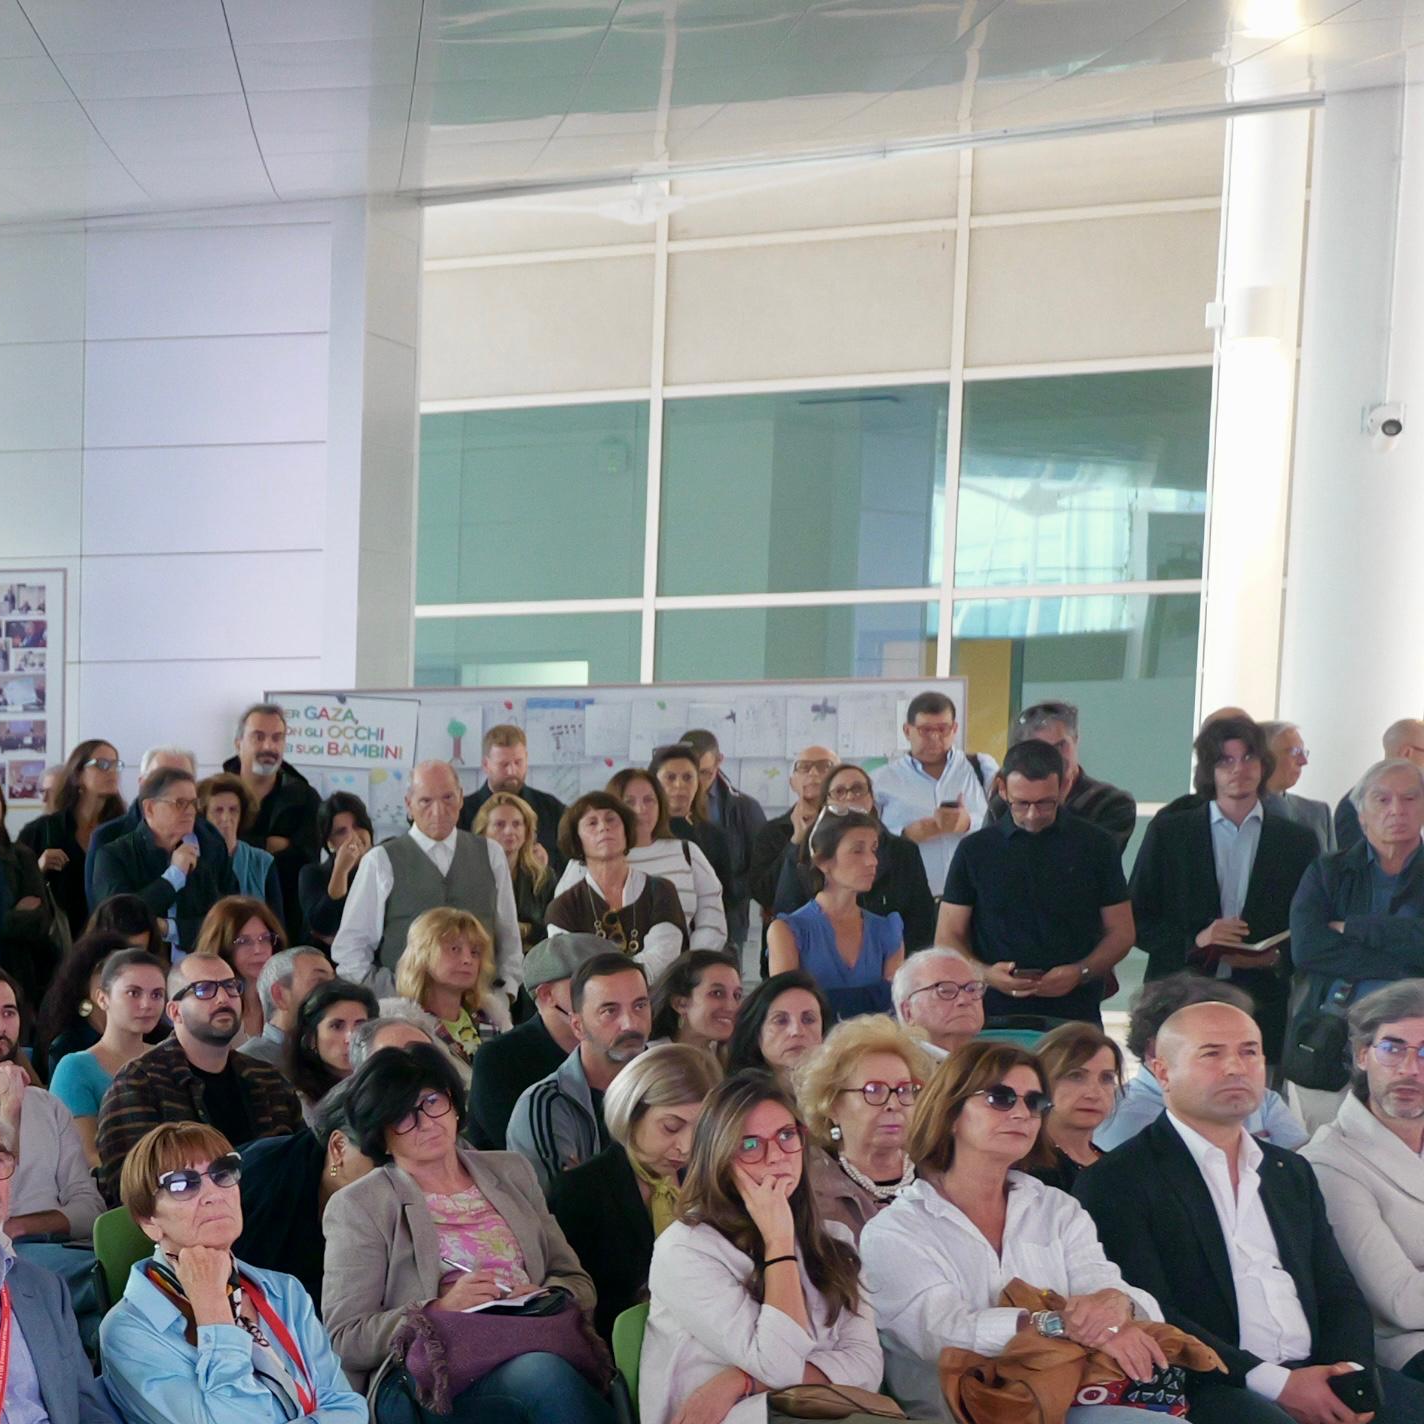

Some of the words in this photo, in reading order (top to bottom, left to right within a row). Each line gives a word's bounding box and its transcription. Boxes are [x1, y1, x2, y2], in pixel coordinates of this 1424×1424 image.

[284, 709, 301, 719] ER
[304, 706, 359, 725] GAZA,
[284, 727, 303, 737] ON
[304, 727, 324, 738] GLI
[327, 725, 385, 741] OCCHI
[296, 744, 324, 754] SUOI
[327, 741, 404, 760] BAMBINI
